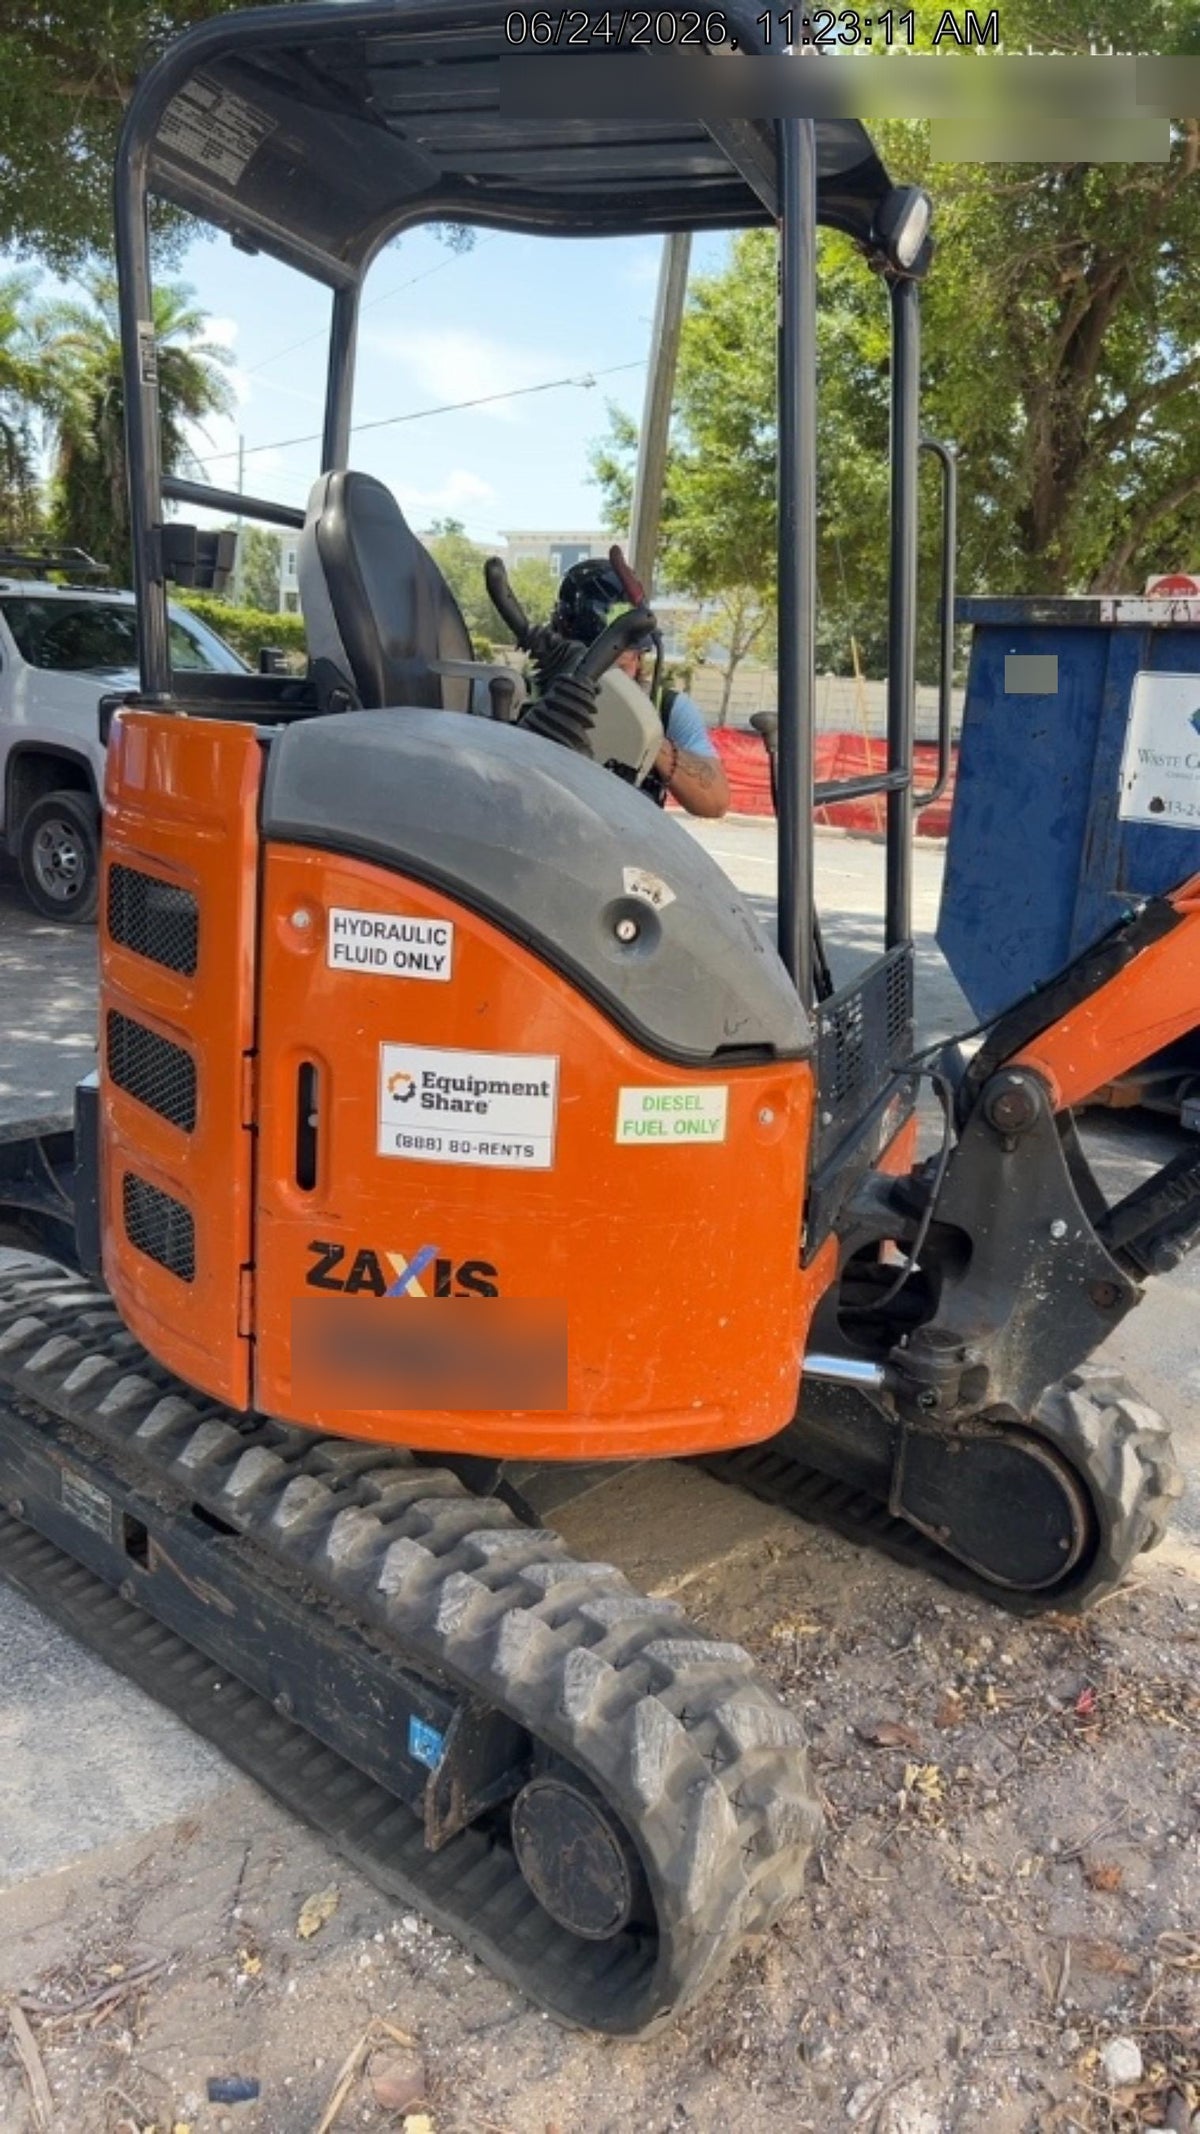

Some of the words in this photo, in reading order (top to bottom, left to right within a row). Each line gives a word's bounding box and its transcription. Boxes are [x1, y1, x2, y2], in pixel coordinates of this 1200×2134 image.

[334, 917, 447, 946] HYDRAULIC
[333, 943, 387, 966] FLUID
[393, 950, 445, 972] ONLY
[421, 1071, 549, 1097] Equipment
[421, 1092, 488, 1114] Share
[642, 1095, 704, 1111] DIESEL
[623, 1120, 668, 1137] FUEL
[673, 1119, 720, 1135] ONLY
[396, 1133, 442, 1152] (888)
[449, 1140, 534, 1158] 80-RENTS
[306, 1240, 498, 1297] ZAXIS
